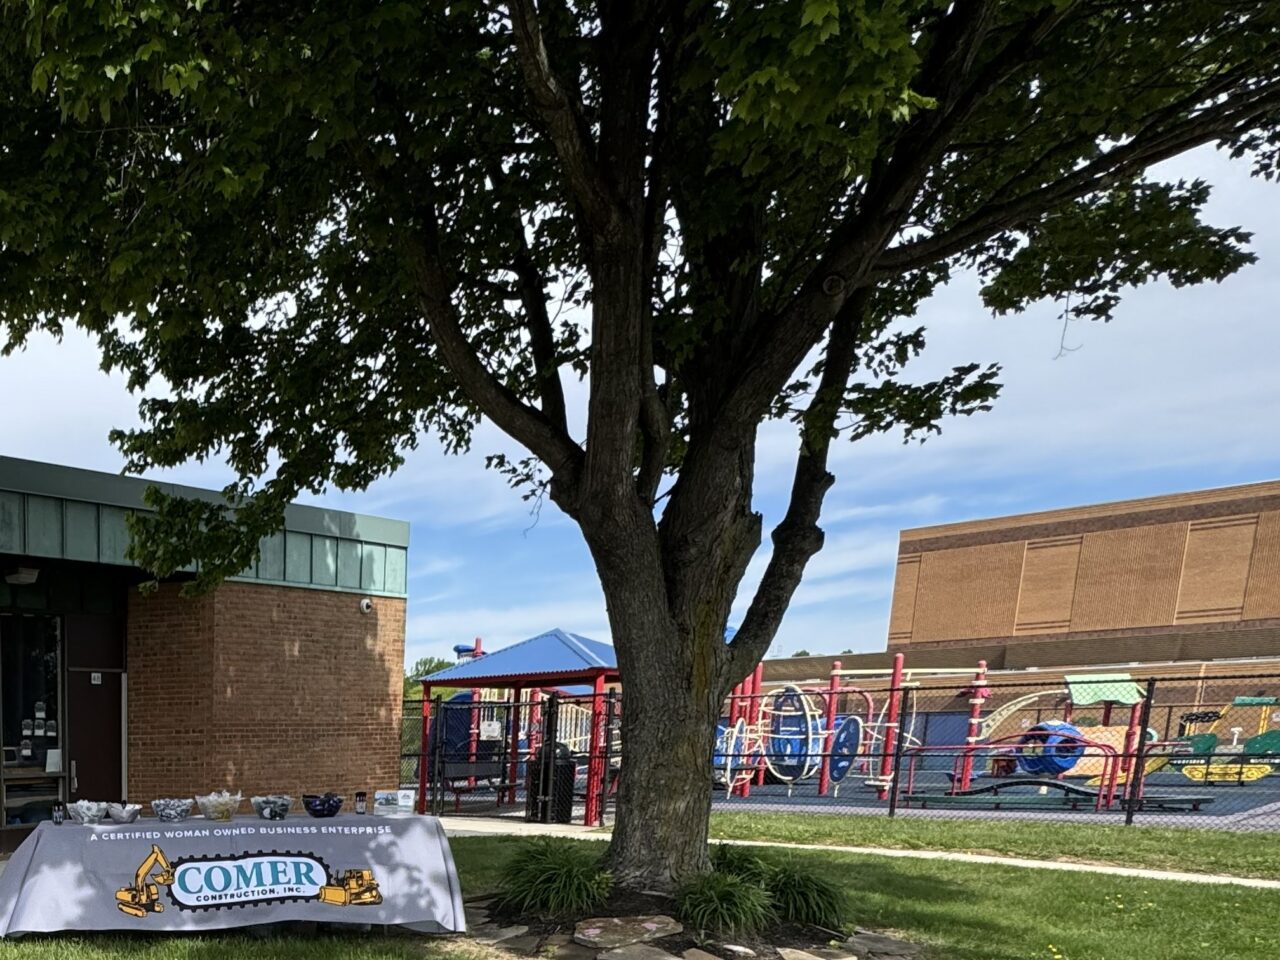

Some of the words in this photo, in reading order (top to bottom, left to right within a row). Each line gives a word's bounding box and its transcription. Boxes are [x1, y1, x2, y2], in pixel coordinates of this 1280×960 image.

[90, 833, 98, 841] A
[101, 831, 161, 840] CERTIFIED
[164, 829, 210, 839] WOMAN
[213, 827, 256, 837] OWNED
[259, 826, 318, 835] BUSINESS
[321, 825, 392, 835] ENTERPRISE
[177, 861, 319, 894] COMER
